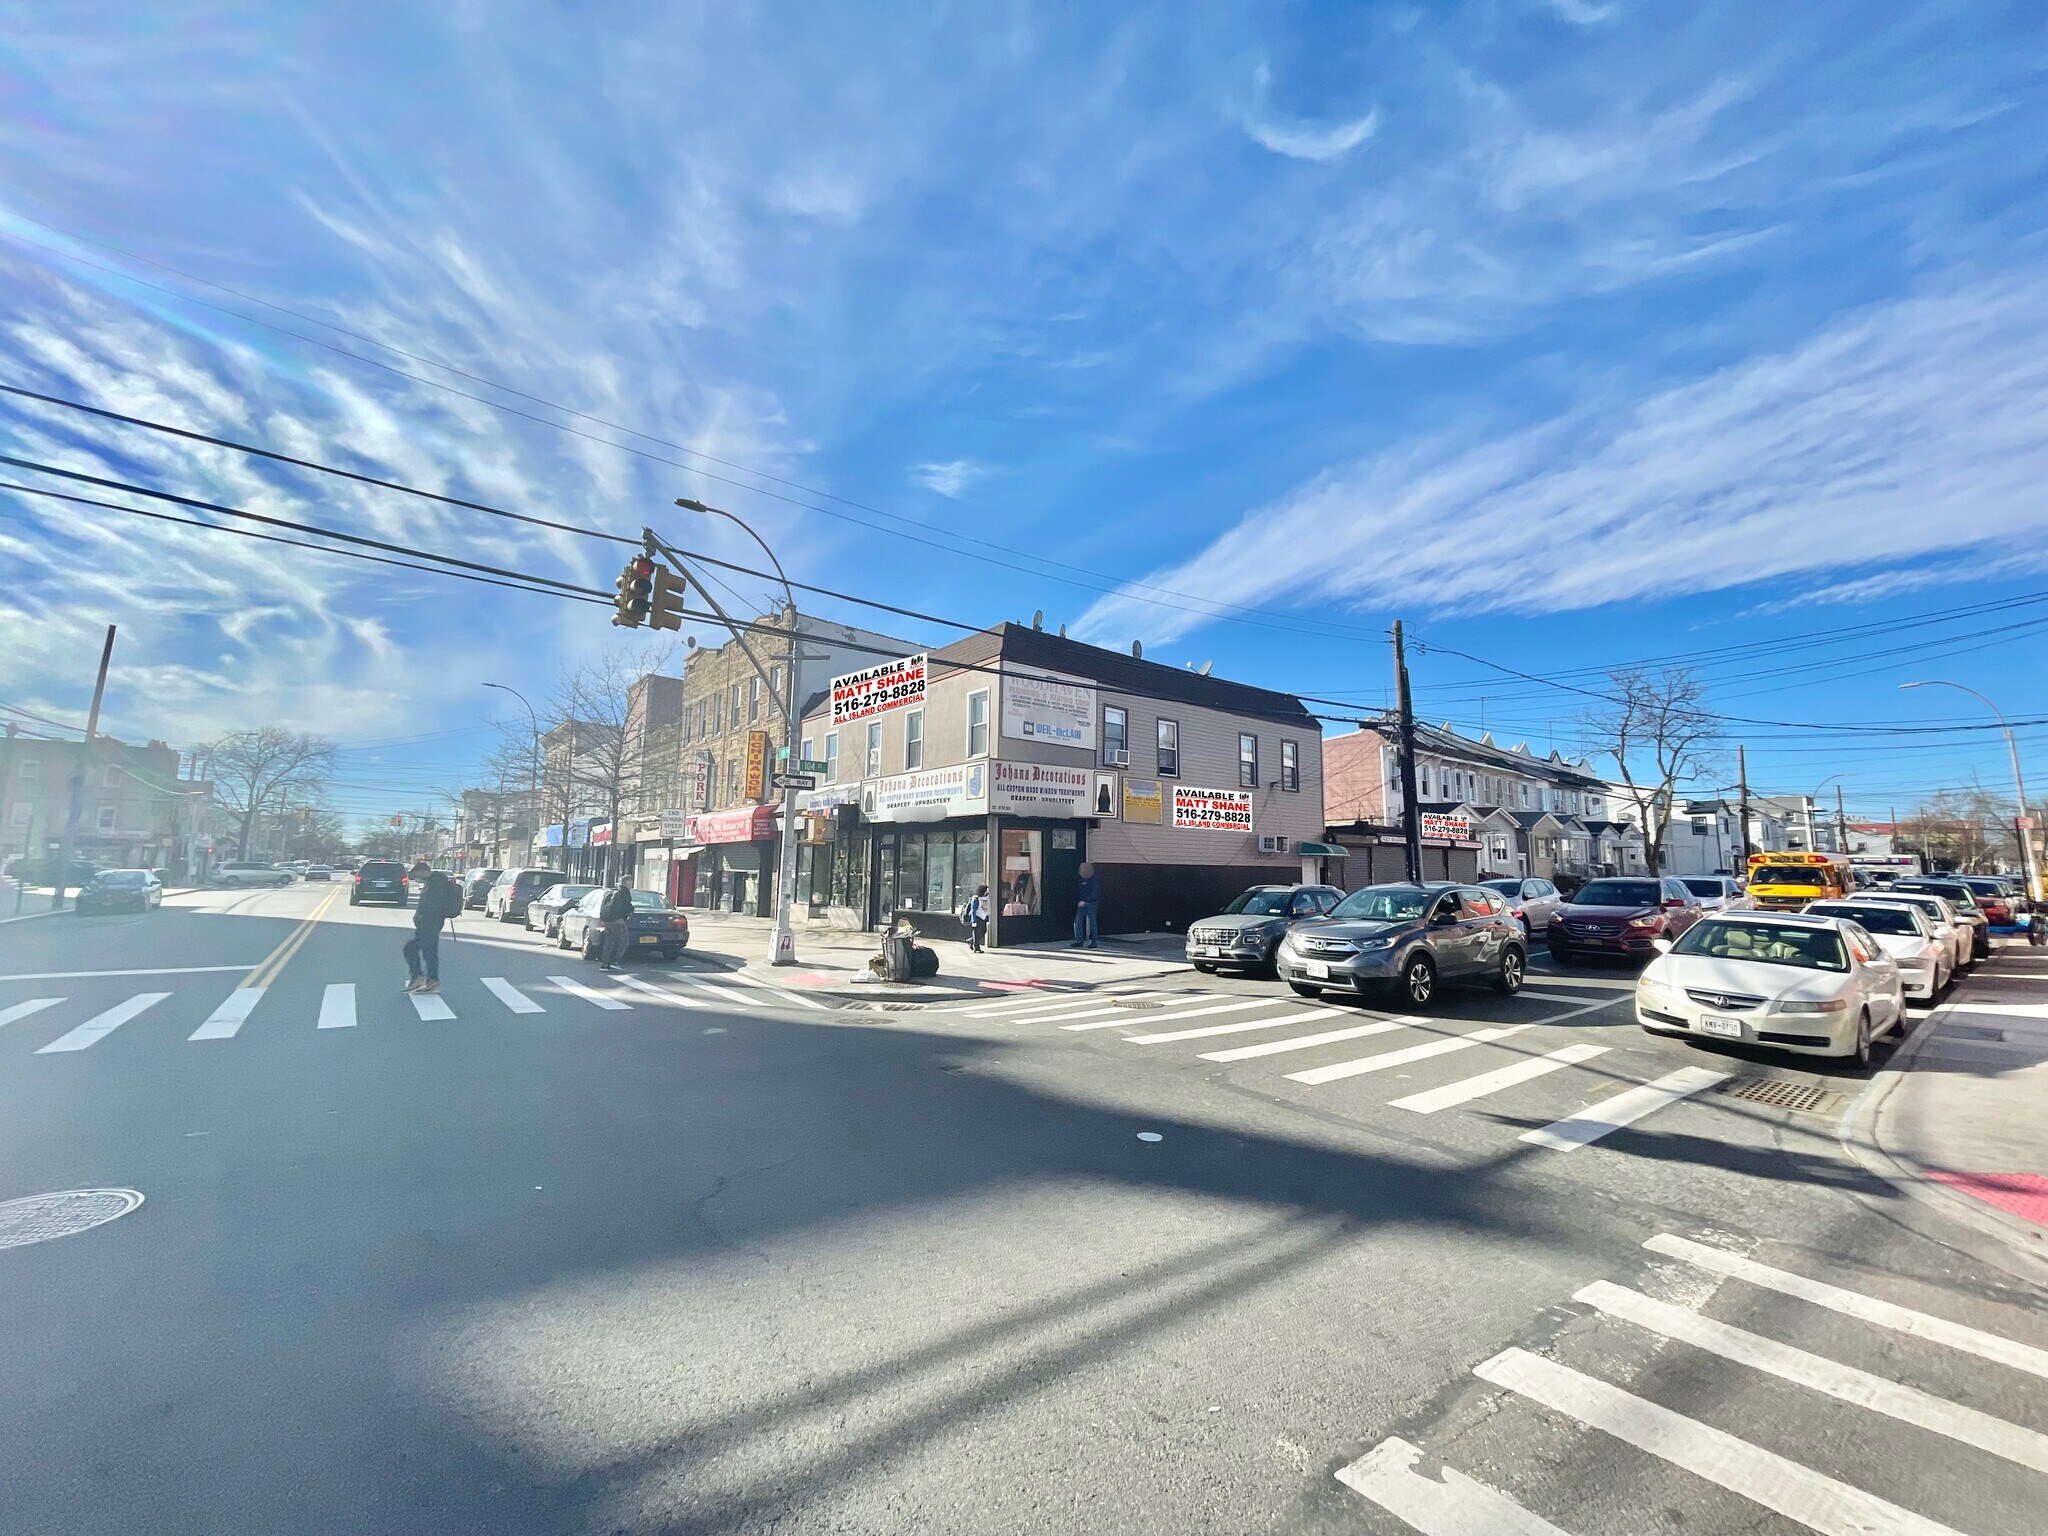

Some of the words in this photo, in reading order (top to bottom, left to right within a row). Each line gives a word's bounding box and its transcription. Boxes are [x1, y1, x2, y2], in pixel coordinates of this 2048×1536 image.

[834, 662, 904, 689] AVAILABLE
[834, 682, 872, 702] MATT
[877, 668, 924, 690] SHANE
[834, 680, 925, 715] 516-279-8828
[834, 714, 847, 724] ALL
[850, 706, 875, 720] ISLAND
[877, 693, 924, 712] COMMERCIAL
[804, 762, 815, 771] 104
[995, 763, 1030, 782] Johana
[1032, 766, 1086, 786] Decorations
[696, 764, 706, 800] PORK
[748, 774, 760, 792] WOK
[879, 780, 906, 794] Johana
[910, 770, 963, 789] Decorations
[915, 798, 950, 806] UPHOLSTERY
[1176, 789, 1234, 800] AVAILABLE
[1176, 798, 1208, 808] MATT
[1212, 801, 1250, 812] SHANE
[1176, 808, 1250, 823] 516-279-8828
[1189, 820, 1210, 828] ISLAND
[1212, 822, 1250, 830] COMMERCIAL
[1424, 826, 1468, 834] 516-279-8828
[1444, 820, 1467, 828] SHANE
